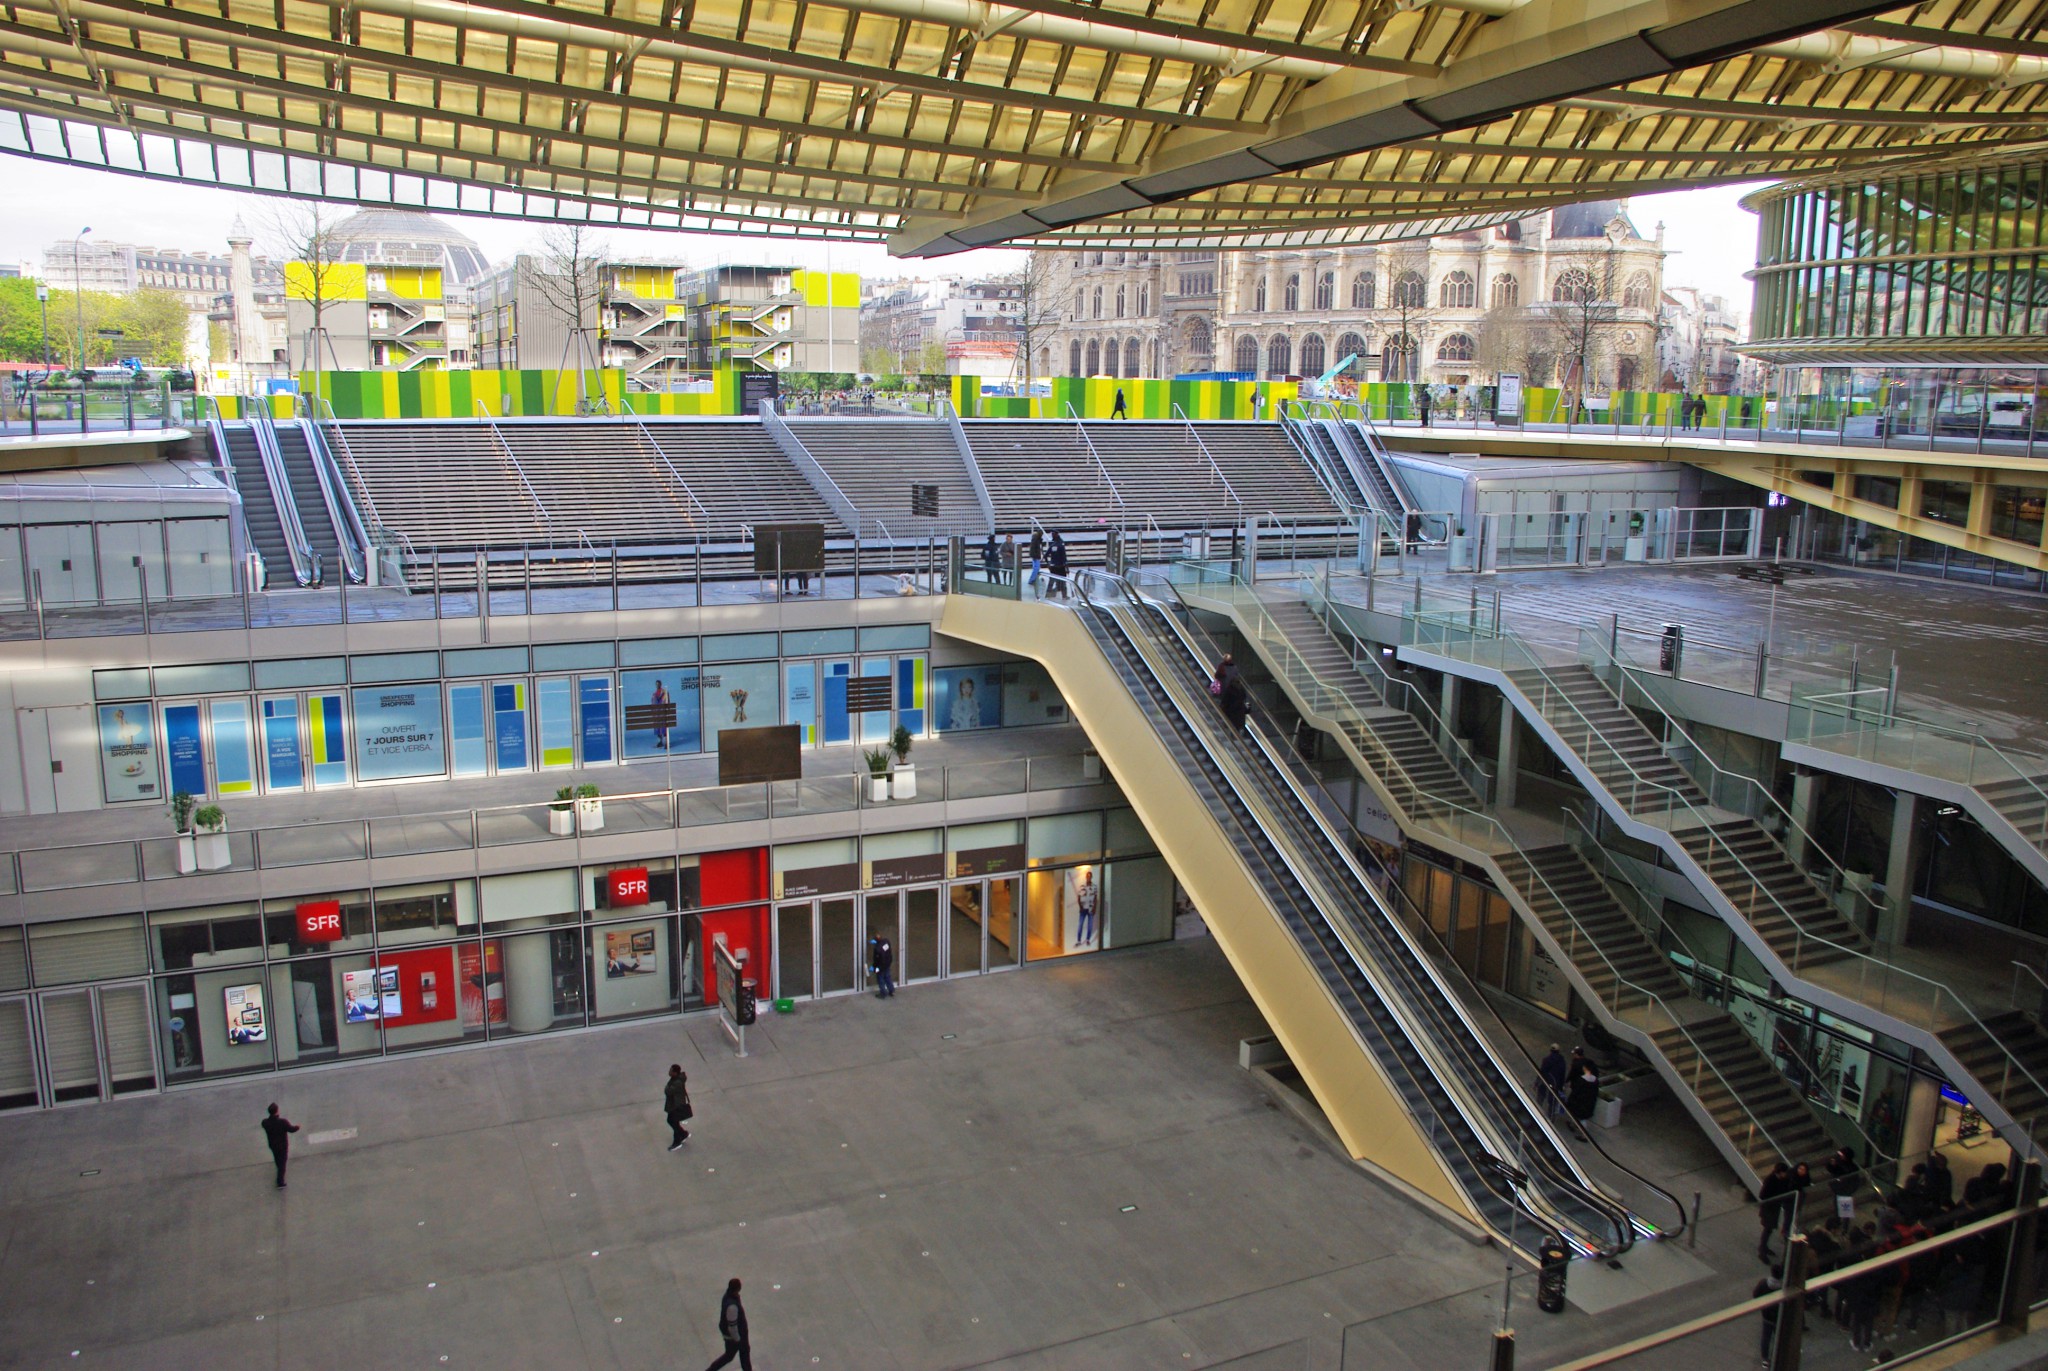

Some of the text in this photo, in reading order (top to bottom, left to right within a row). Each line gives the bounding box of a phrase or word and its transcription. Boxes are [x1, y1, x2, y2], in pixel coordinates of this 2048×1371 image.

[380, 700, 415, 708] SHOPPING
[382, 724, 416, 734] OUVERT
[373, 736, 405, 745] JOURS
[407, 733, 426, 742] SUR
[111, 749, 148, 757] SHOPPING
[368, 743, 432, 755] ET VICE VERSA.
[618, 880, 647, 896] SFR
[307, 914, 340, 931] SFR
